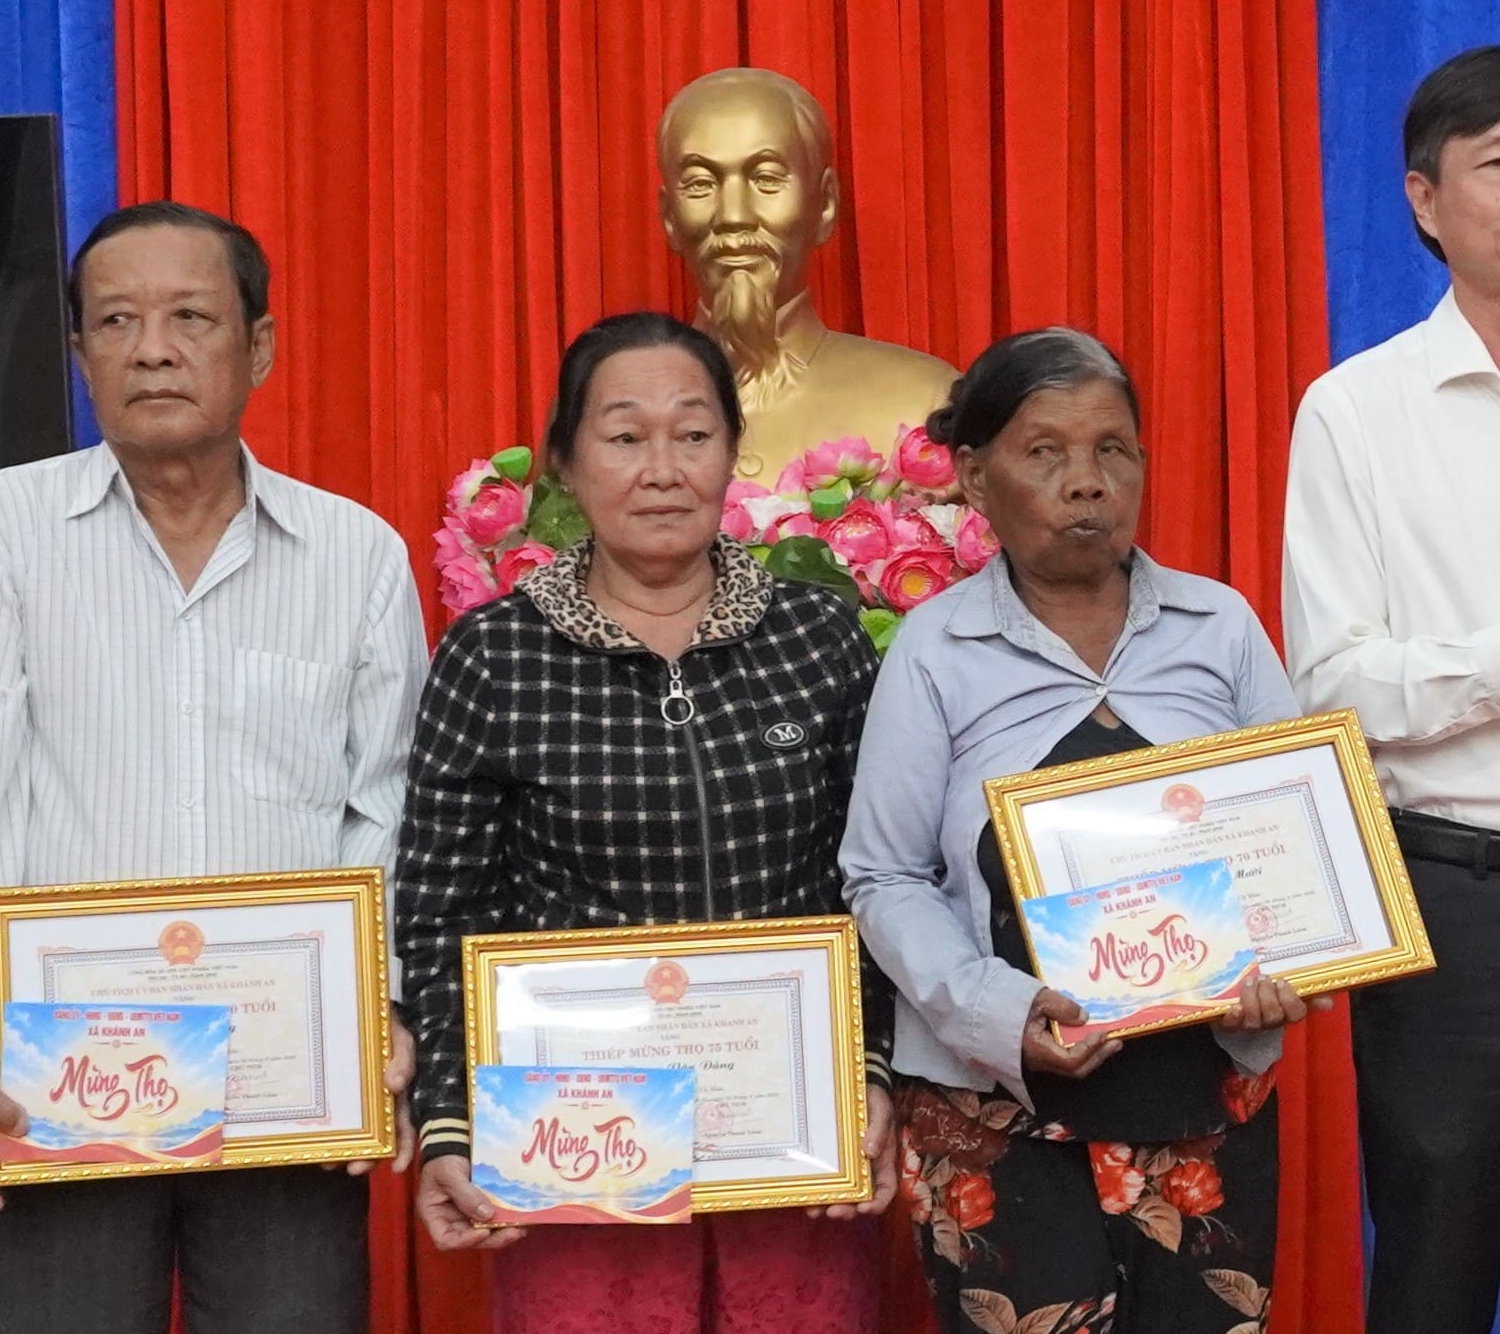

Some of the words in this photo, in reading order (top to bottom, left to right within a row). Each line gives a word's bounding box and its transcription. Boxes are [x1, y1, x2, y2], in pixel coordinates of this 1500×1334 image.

[773, 725, 797, 742] M
[1088, 931, 1165, 987] Mừng
[1148, 913, 1209, 971] Thọ
[629, 1043, 671, 1058] MỪNG
[676, 1043, 704, 1056] THỌ
[726, 1035, 760, 1052] TUỔI
[49, 1054, 131, 1121] Mừng
[124, 1054, 179, 1117] Thọ
[521, 1115, 600, 1182] Mừng
[593, 1115, 648, 1179] Thọ
